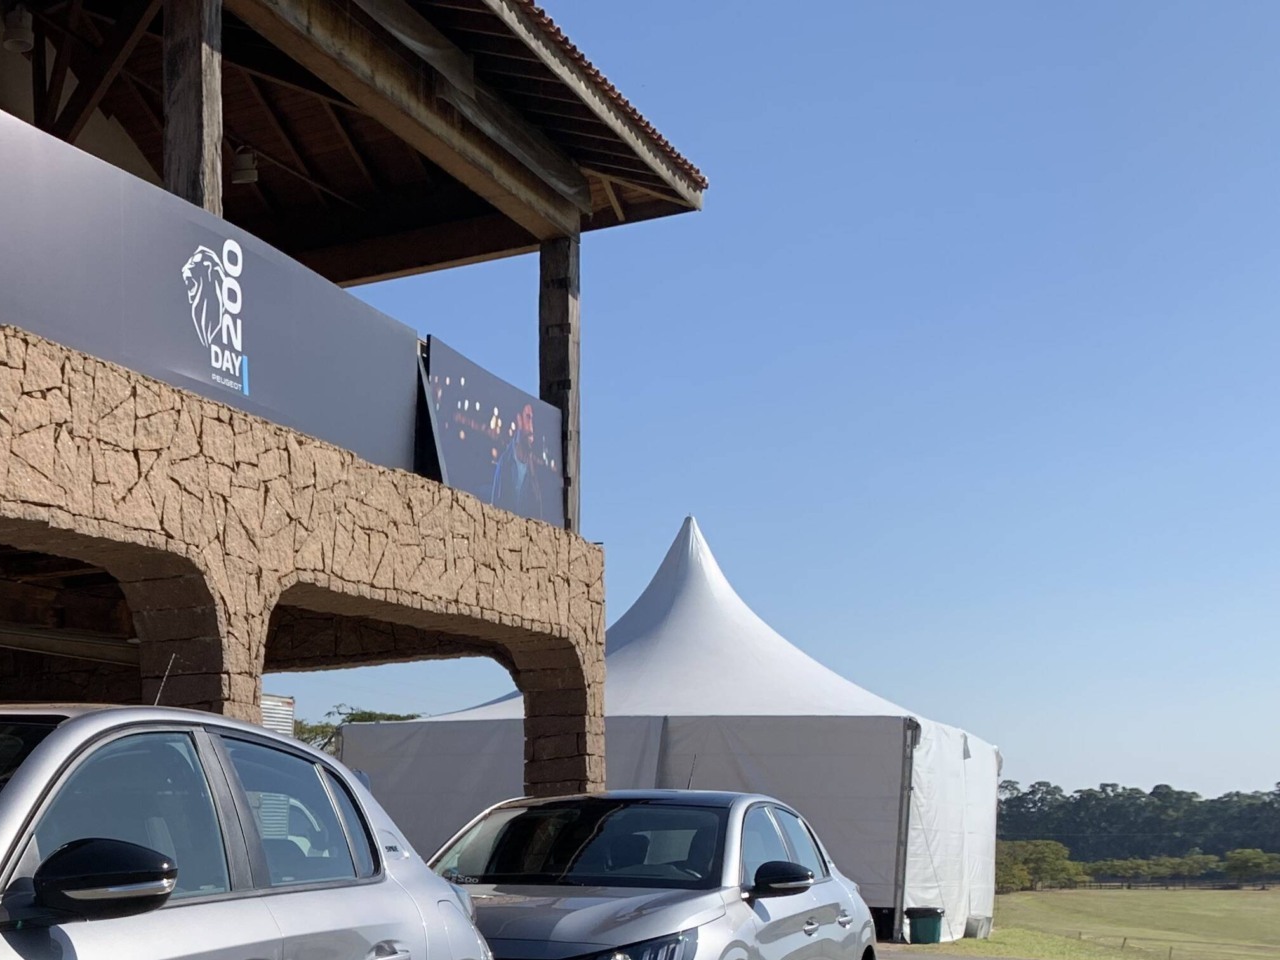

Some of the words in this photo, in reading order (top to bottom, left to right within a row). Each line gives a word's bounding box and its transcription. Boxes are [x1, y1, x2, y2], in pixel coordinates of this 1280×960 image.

[222, 239, 243, 352] 200
[210, 343, 243, 377] DAY
[211, 373, 243, 391] PEUGEOT
